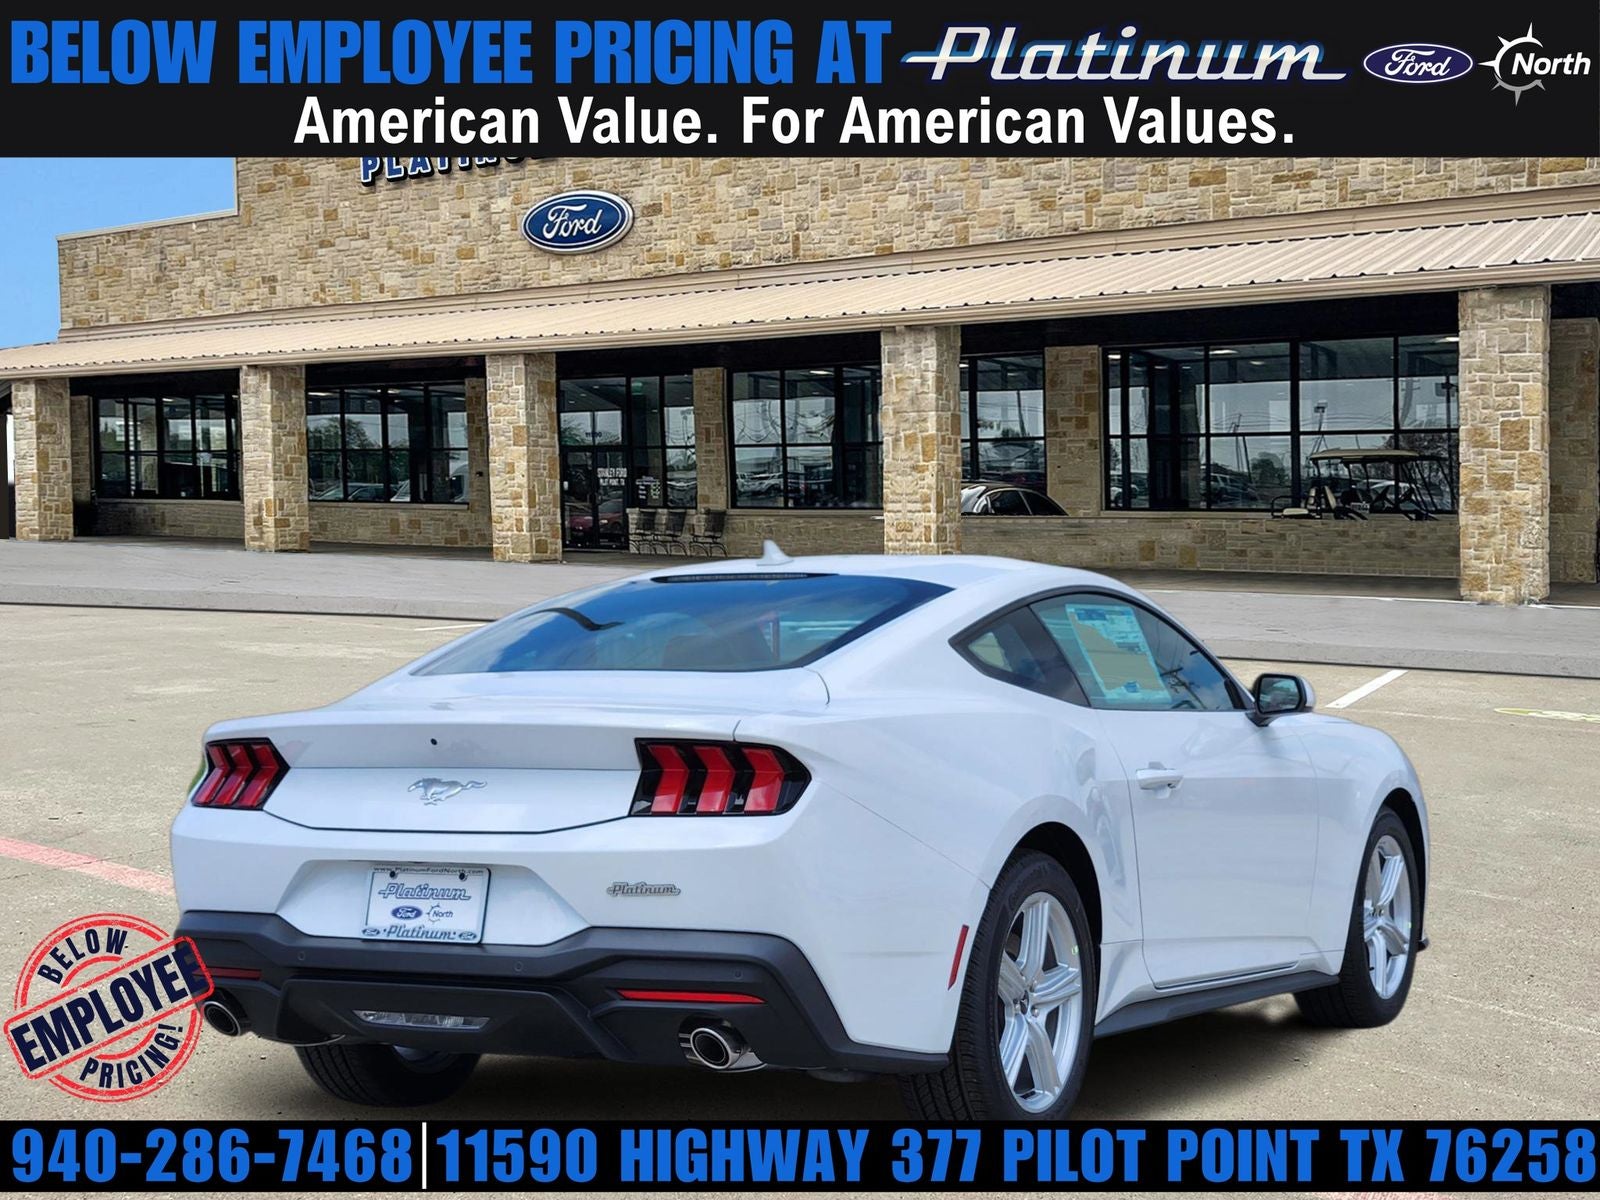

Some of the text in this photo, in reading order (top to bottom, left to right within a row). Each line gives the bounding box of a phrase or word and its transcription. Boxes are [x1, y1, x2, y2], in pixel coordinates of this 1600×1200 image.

[542, 203, 603, 239] Ford
[378, 882, 472, 901] Platinum
[607, 881, 681, 897] Platinum
[432, 909, 453, 918] North
[386, 924, 456, 940] Platinum
